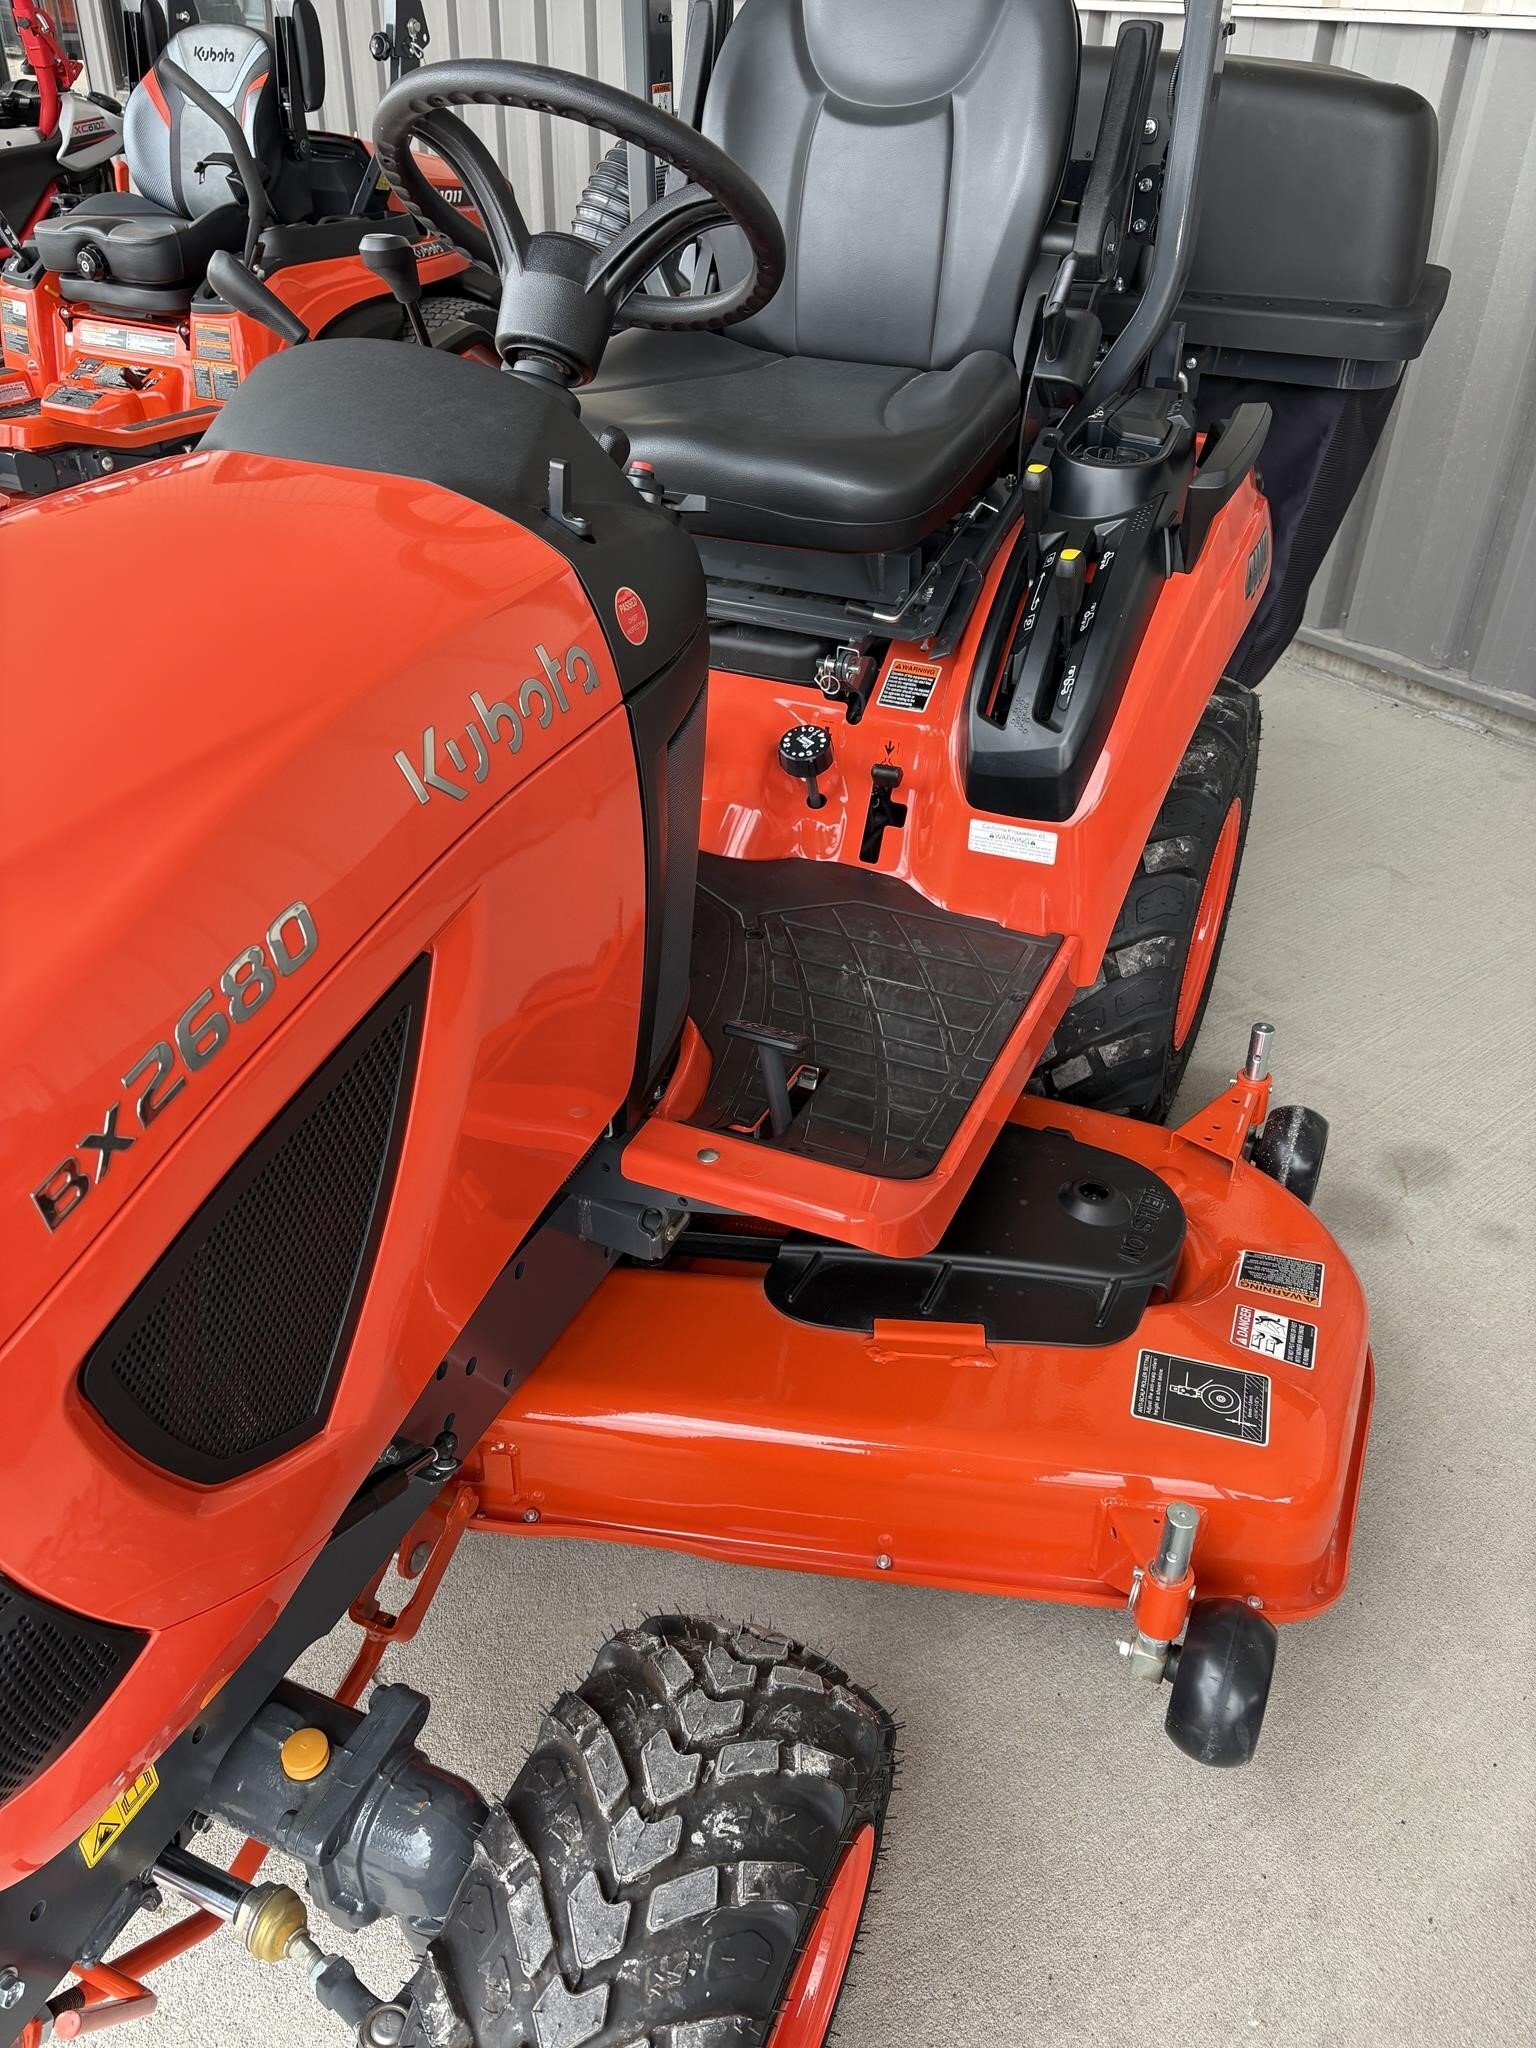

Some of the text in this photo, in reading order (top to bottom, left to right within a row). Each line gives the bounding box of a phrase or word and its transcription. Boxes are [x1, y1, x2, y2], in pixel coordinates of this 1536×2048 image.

[194, 46, 235, 62] Kubota
[902, 664, 936, 675] WARNING
[393, 644, 600, 805] Kubota
[995, 833, 1030, 845] WARNING
[30, 900, 319, 1234] BX2680
[1118, 1232, 1150, 1265] NO
[1240, 1280, 1302, 1301] WARNING
[1236, 1307, 1253, 1338] DANGER
[1137, 1388, 1146, 1413] ANTI-SCALP
